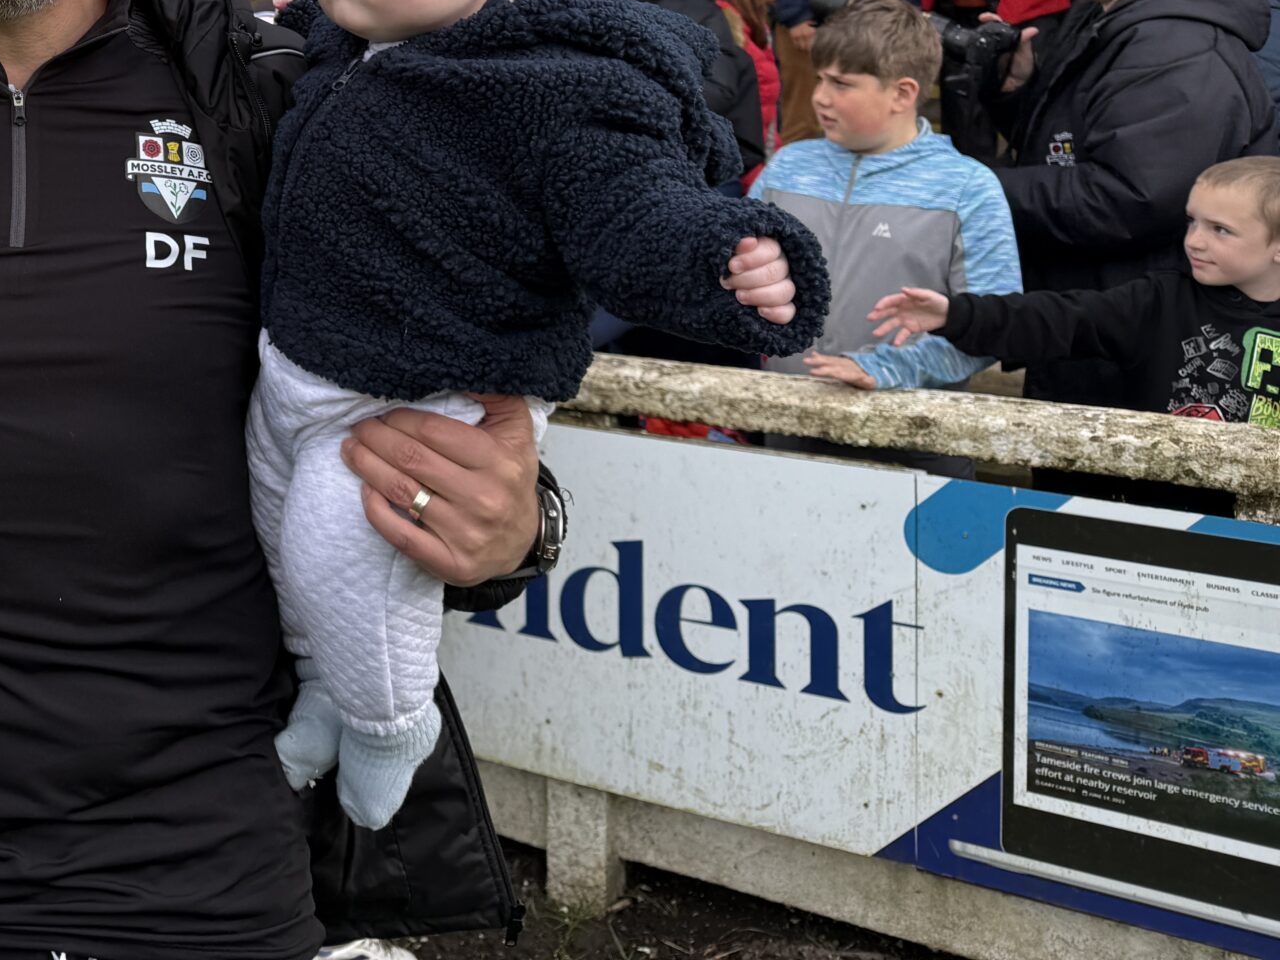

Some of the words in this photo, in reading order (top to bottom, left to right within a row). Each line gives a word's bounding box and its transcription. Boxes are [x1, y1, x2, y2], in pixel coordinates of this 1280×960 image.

[131, 162, 185, 177] MOSSLEY
[145, 231, 210, 271] DF
[1061, 559, 1095, 570] LIFESTYLE
[1104, 566, 1127, 575] SPORT
[1136, 571, 1195, 587] ENTERTAINMENT
[1206, 582, 1241, 594] BUSINESS
[1035, 752, 1082, 772] Tameside
[1083, 763, 1101, 776] fire
[1102, 769, 1131, 783] crews
[1132, 774, 1153, 787] join
[1154, 779, 1180, 794] large
[1182, 787, 1241, 809] emergency
[1241, 800, 1280, 816] service
[1035, 767, 1062, 780] effort
[1064, 772, 1074, 783] at
[1076, 776, 1110, 793] nearby
[1112, 784, 1158, 802] reservoir
